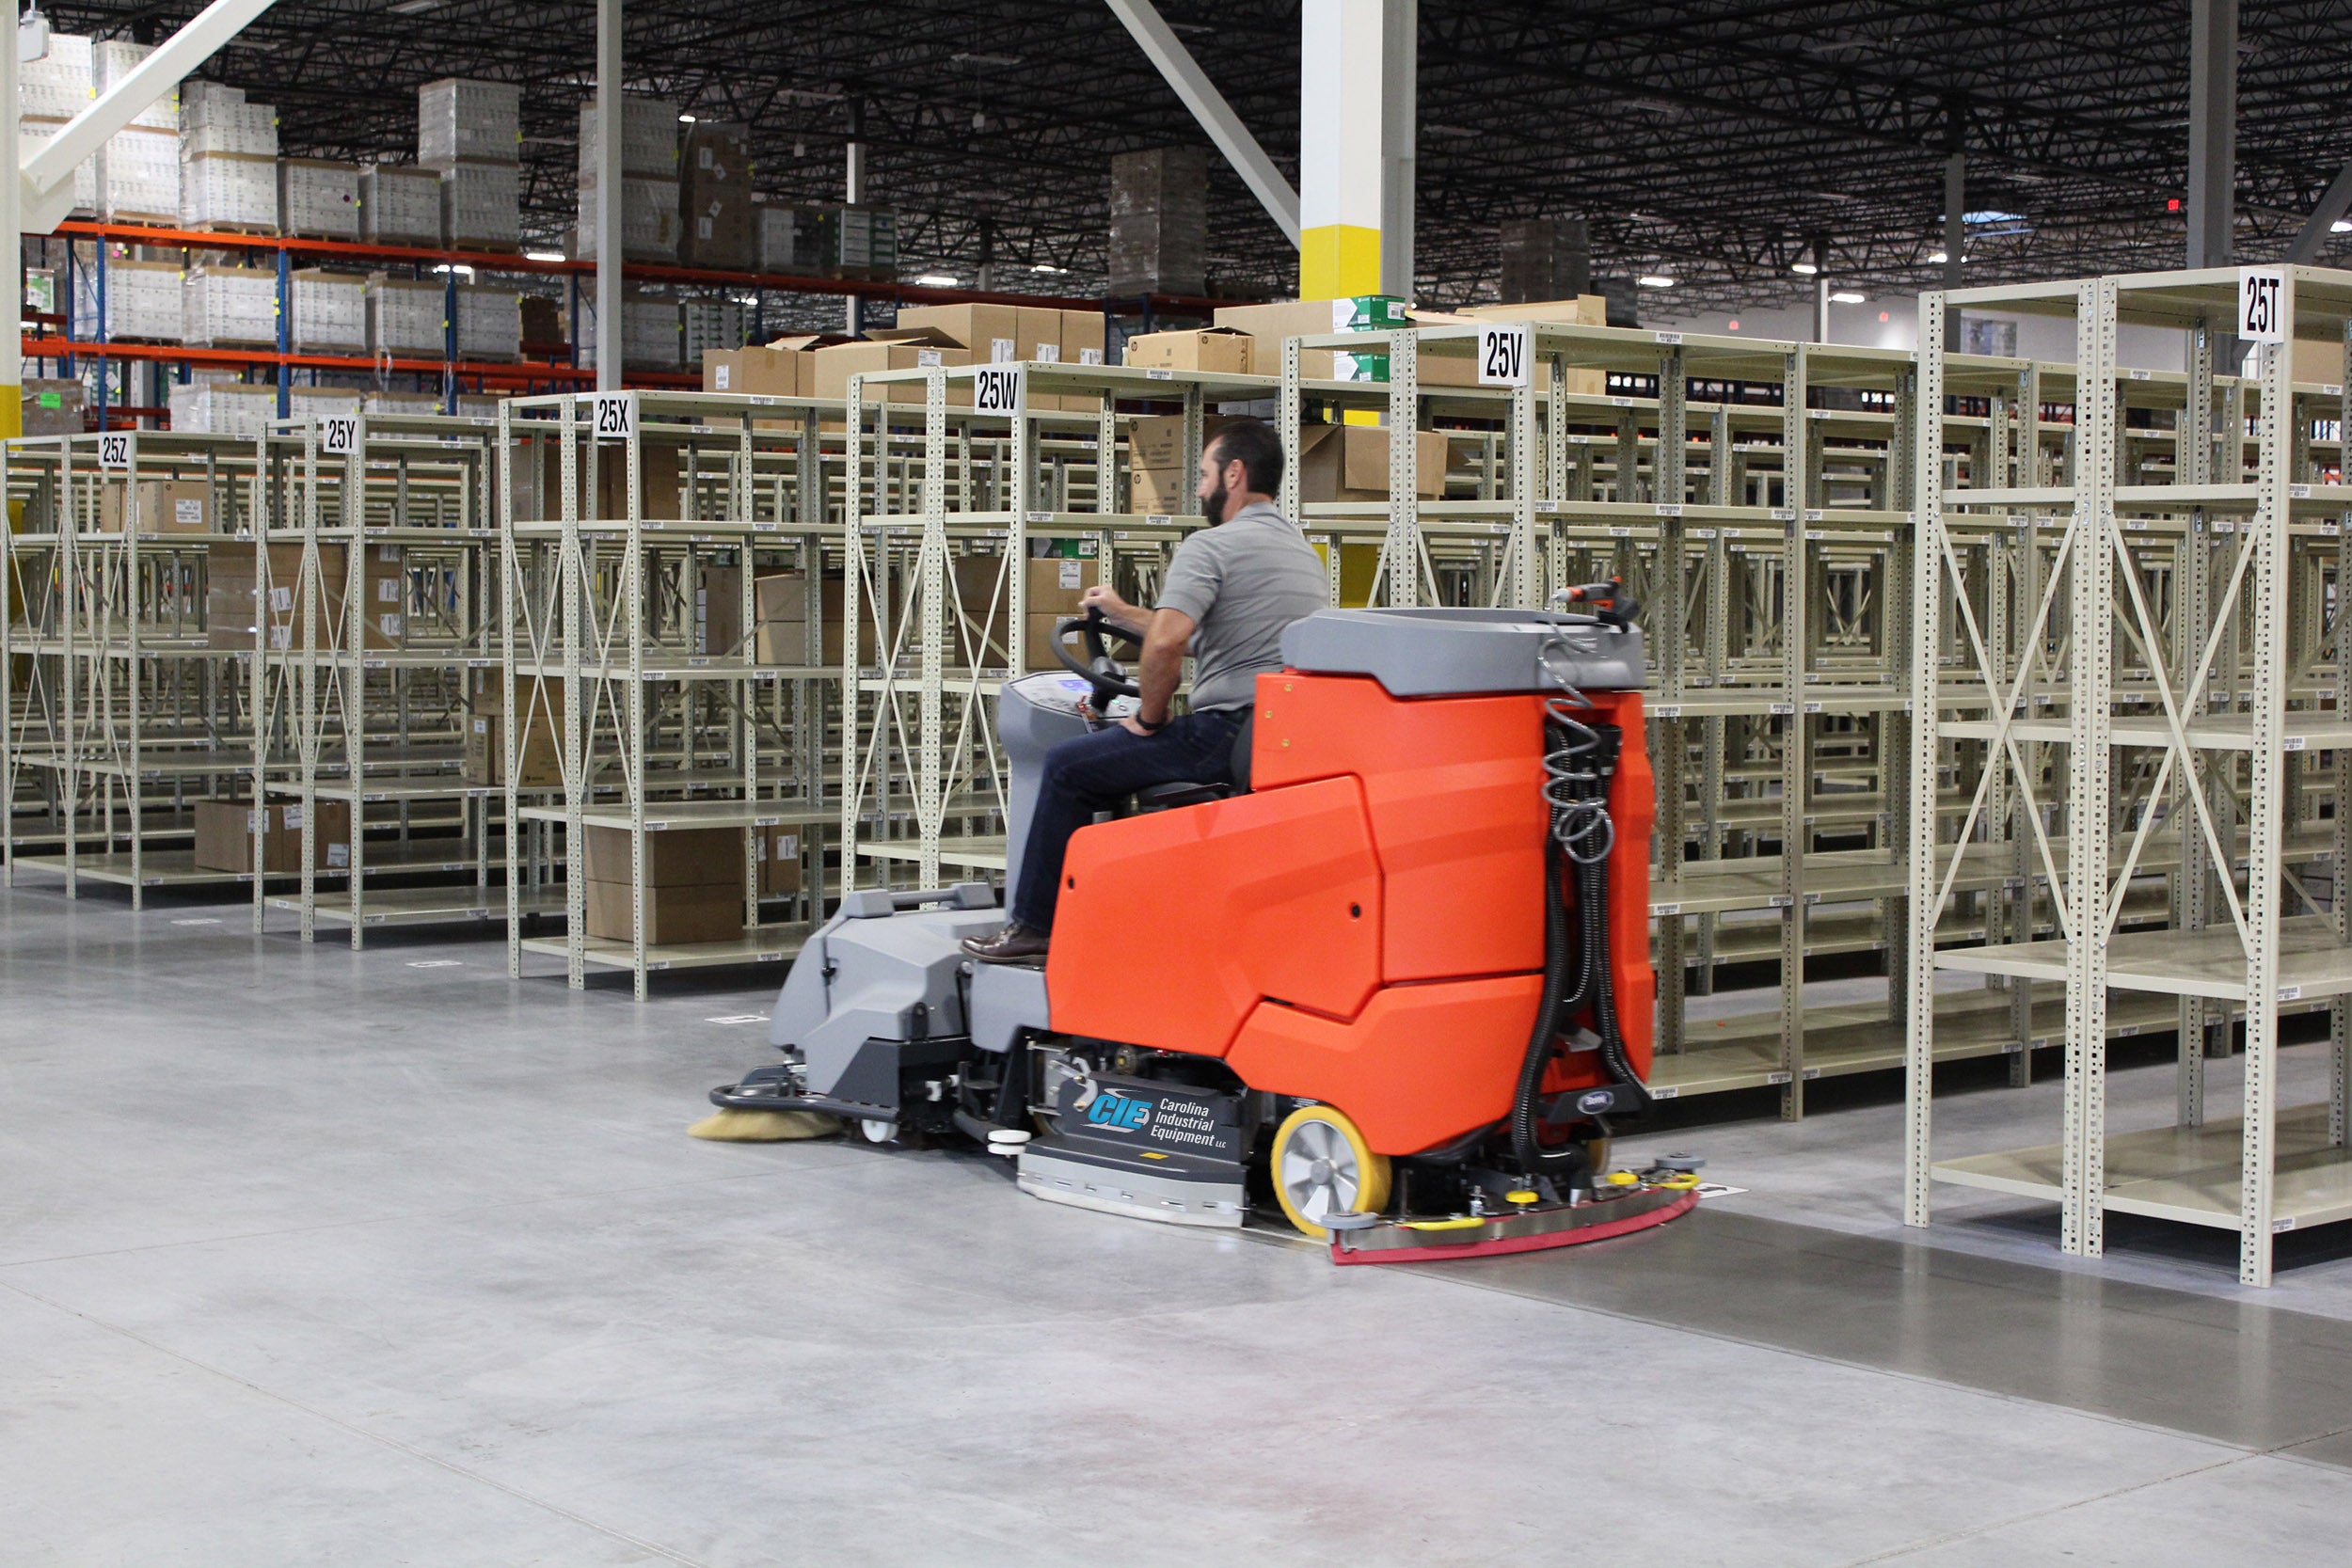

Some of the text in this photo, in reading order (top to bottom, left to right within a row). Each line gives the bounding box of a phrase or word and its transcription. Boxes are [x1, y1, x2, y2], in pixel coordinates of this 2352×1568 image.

[2247, 277, 2280, 333] 25T
[1486, 331, 1523, 377] 25V
[978, 371, 1018, 409] 25W
[598, 399, 629, 433] 25X
[103, 436, 127, 463] 25Z
[328, 420, 356, 449] 25Y
[1088, 1094, 1153, 1130] CIE
[1155, 1111, 1215, 1132] Industrial
[1159, 1098, 1210, 1117] Carolina
[1150, 1125, 1227, 1148] Equipment LLC
